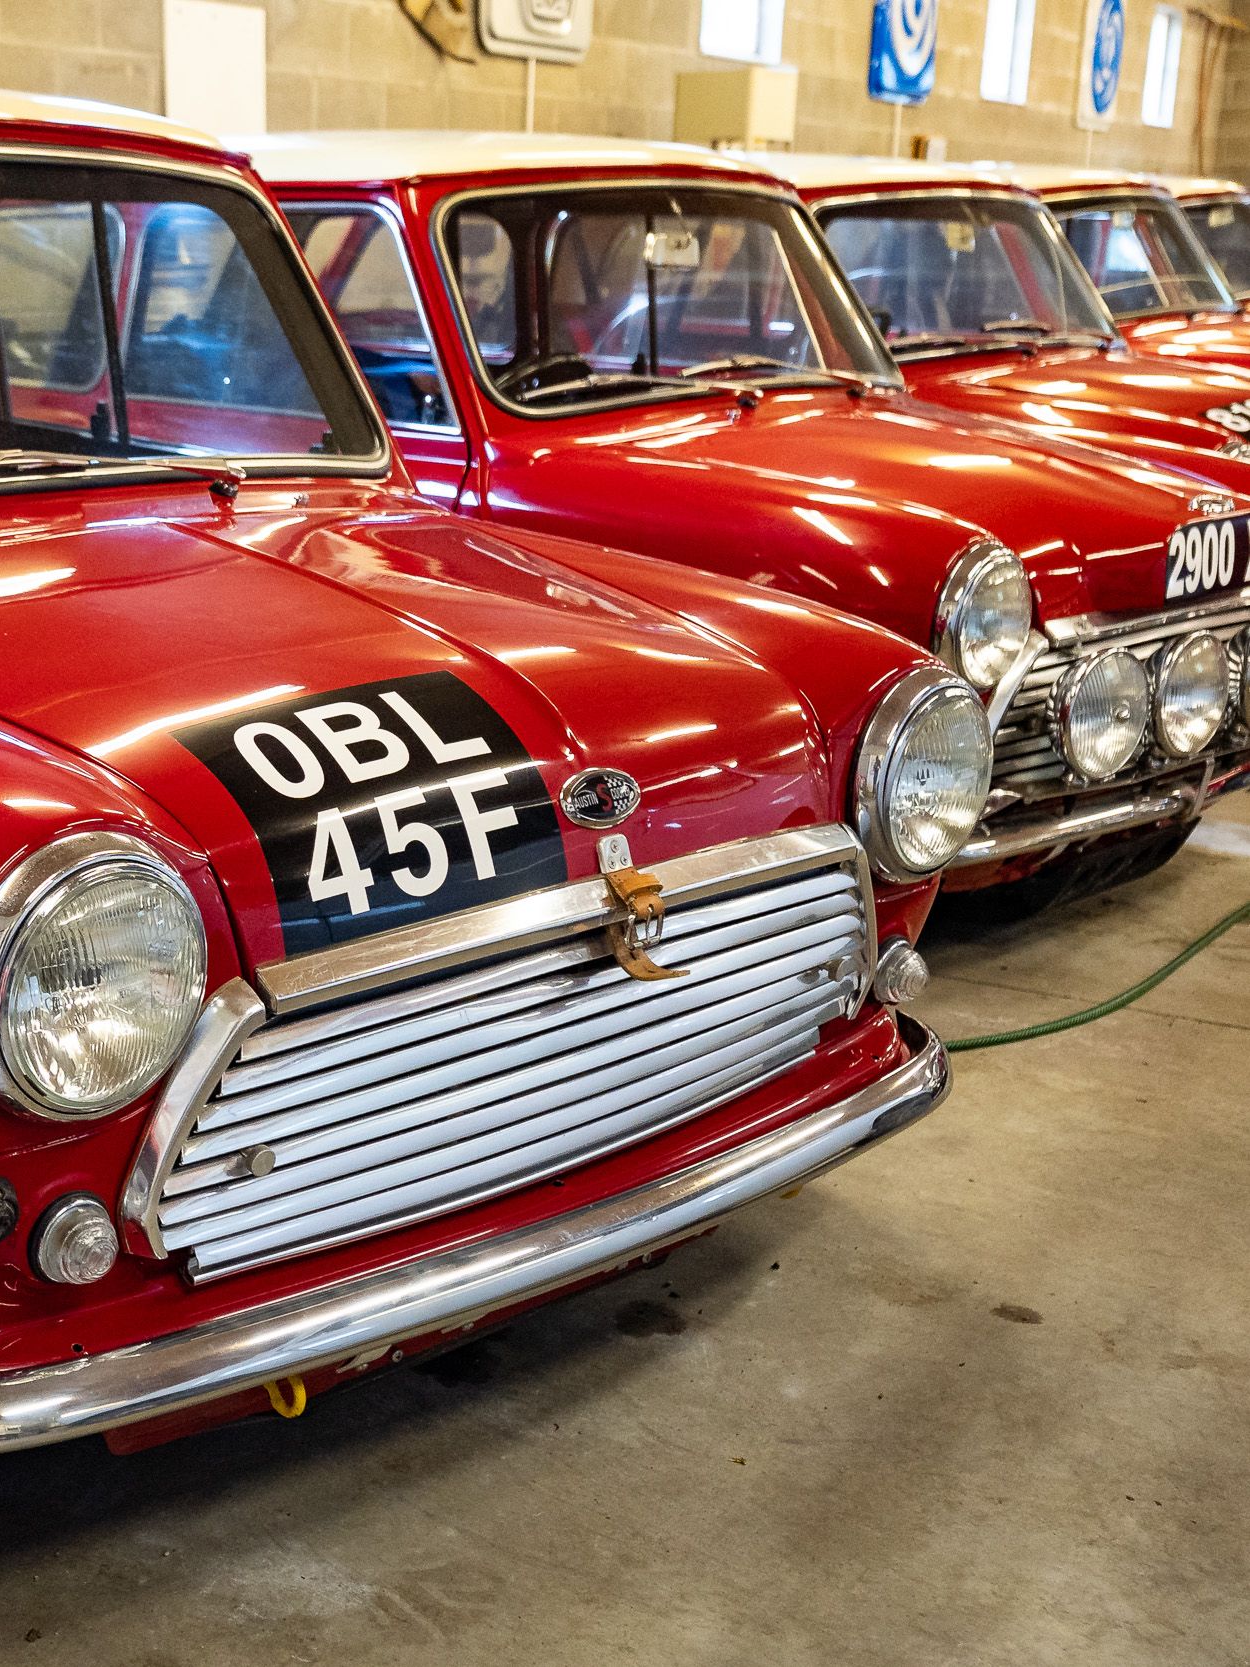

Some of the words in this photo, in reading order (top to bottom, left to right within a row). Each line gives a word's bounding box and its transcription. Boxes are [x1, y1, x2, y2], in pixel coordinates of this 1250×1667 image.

[1166, 520, 1236, 599] 2900
[574, 792, 599, 809] AUSTIN
[596, 783, 613, 812] S
[307, 767, 519, 916] 45F
